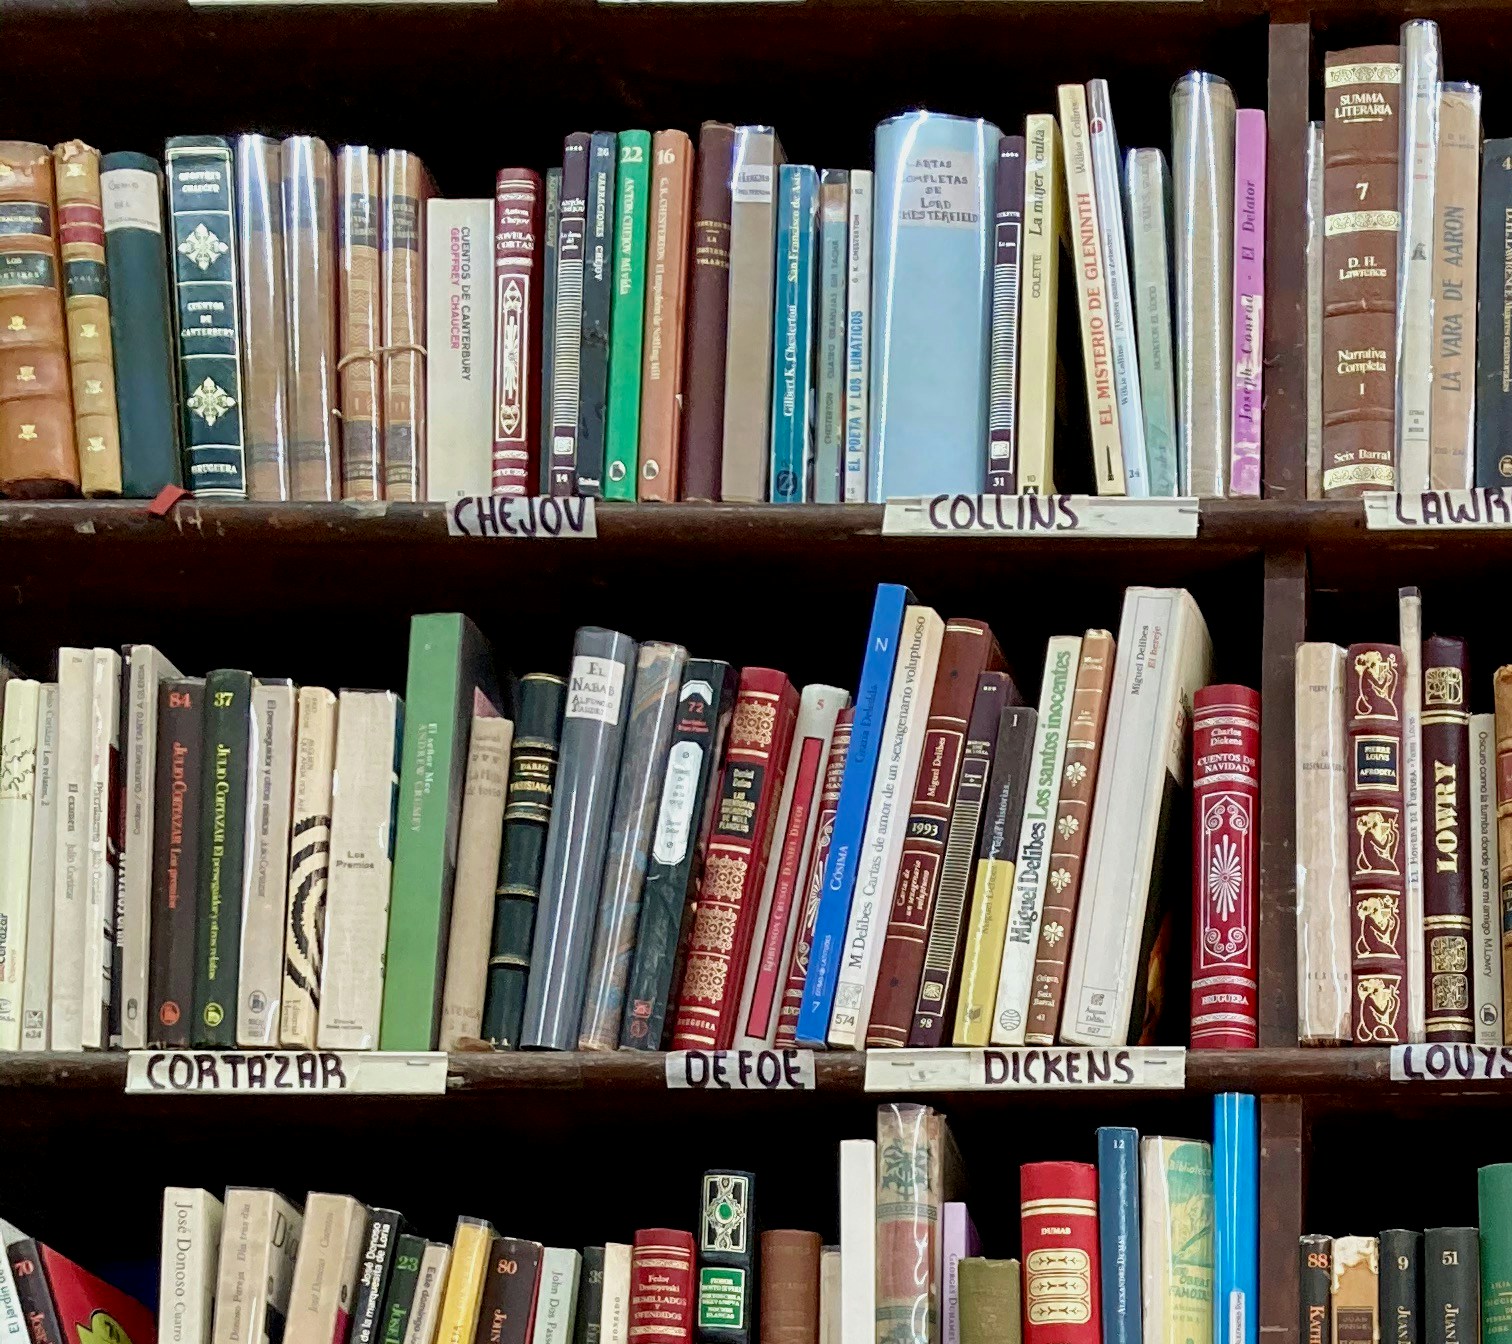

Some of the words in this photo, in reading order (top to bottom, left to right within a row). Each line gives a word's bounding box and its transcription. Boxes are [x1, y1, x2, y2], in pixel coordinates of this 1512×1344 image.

[449, 226, 460, 287] GEOFFREY
[461, 226, 472, 280] CUENTOS
[461, 283, 472, 300] DE
[1087, 286, 1101, 311] DE
[450, 294, 460, 350] CHAUCER
[461, 304, 473, 382] CANTERBURY
[1089, 317, 1111, 400] MISTERIO
[1098, 404, 1113, 426] EL
[454, 496, 589, 537] CHEJOV
[929, 494, 1079, 532] COLLINS
[214, 691, 234, 708] 37
[1436, 760, 1457, 875] LOWRY
[685, 1050, 801, 1087] DEFOE
[984, 1049, 1135, 1085] DICKENS
[1040, 1227, 1071, 1236] DUMAS
[497, 1258, 518, 1276] 80
[1442, 1250, 1460, 1266] 51
